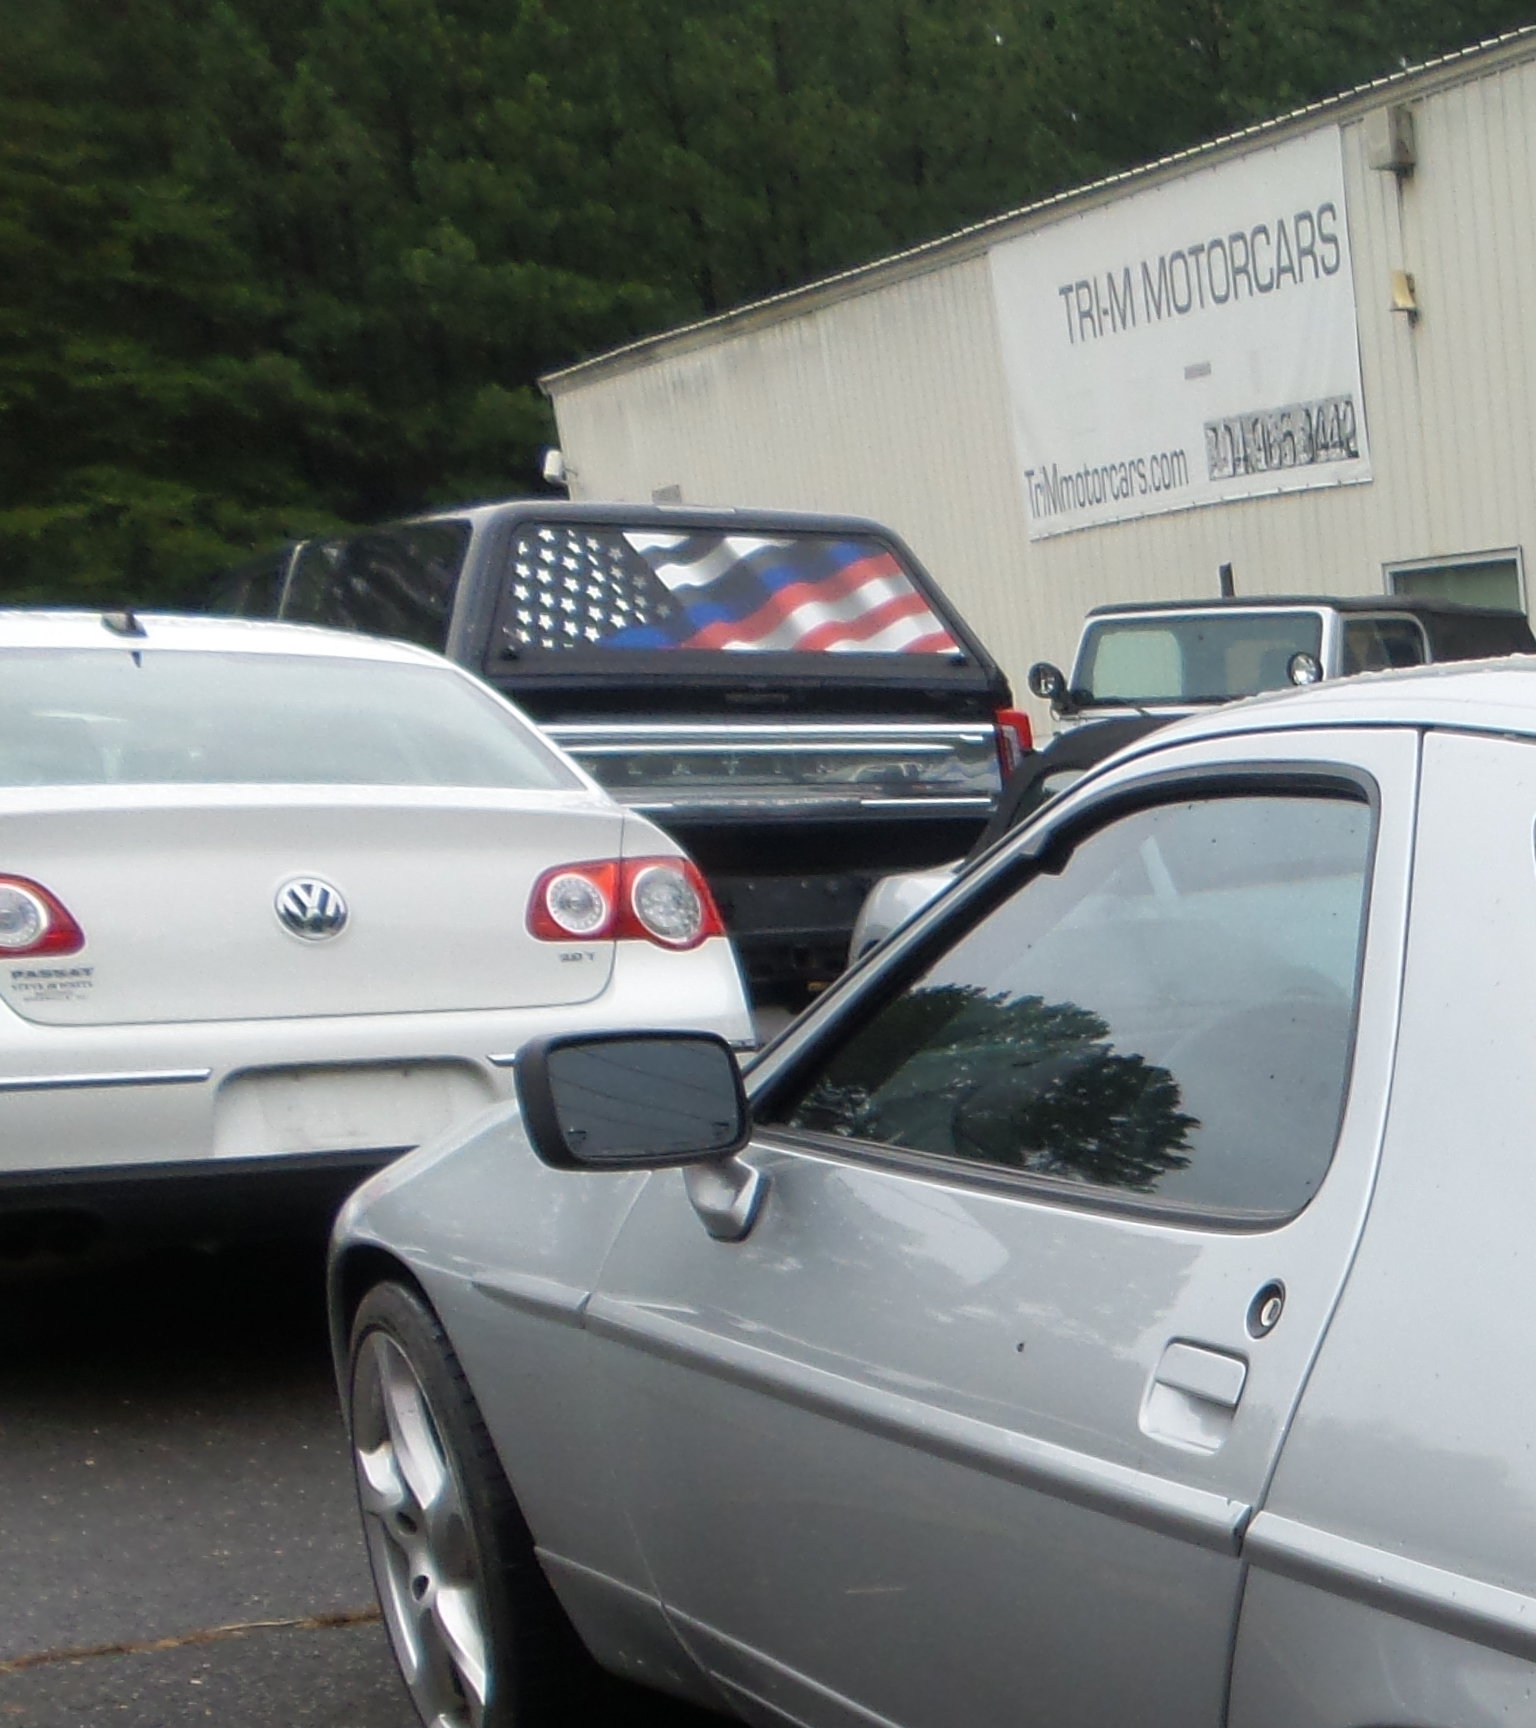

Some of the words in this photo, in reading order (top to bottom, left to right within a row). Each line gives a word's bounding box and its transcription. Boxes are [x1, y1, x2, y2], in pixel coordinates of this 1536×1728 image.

[1058, 266, 1136, 344] TRI-M
[1141, 202, 1341, 324] MOTORCARS
[1024, 449, 1190, 520] TriMmotorcars.com
